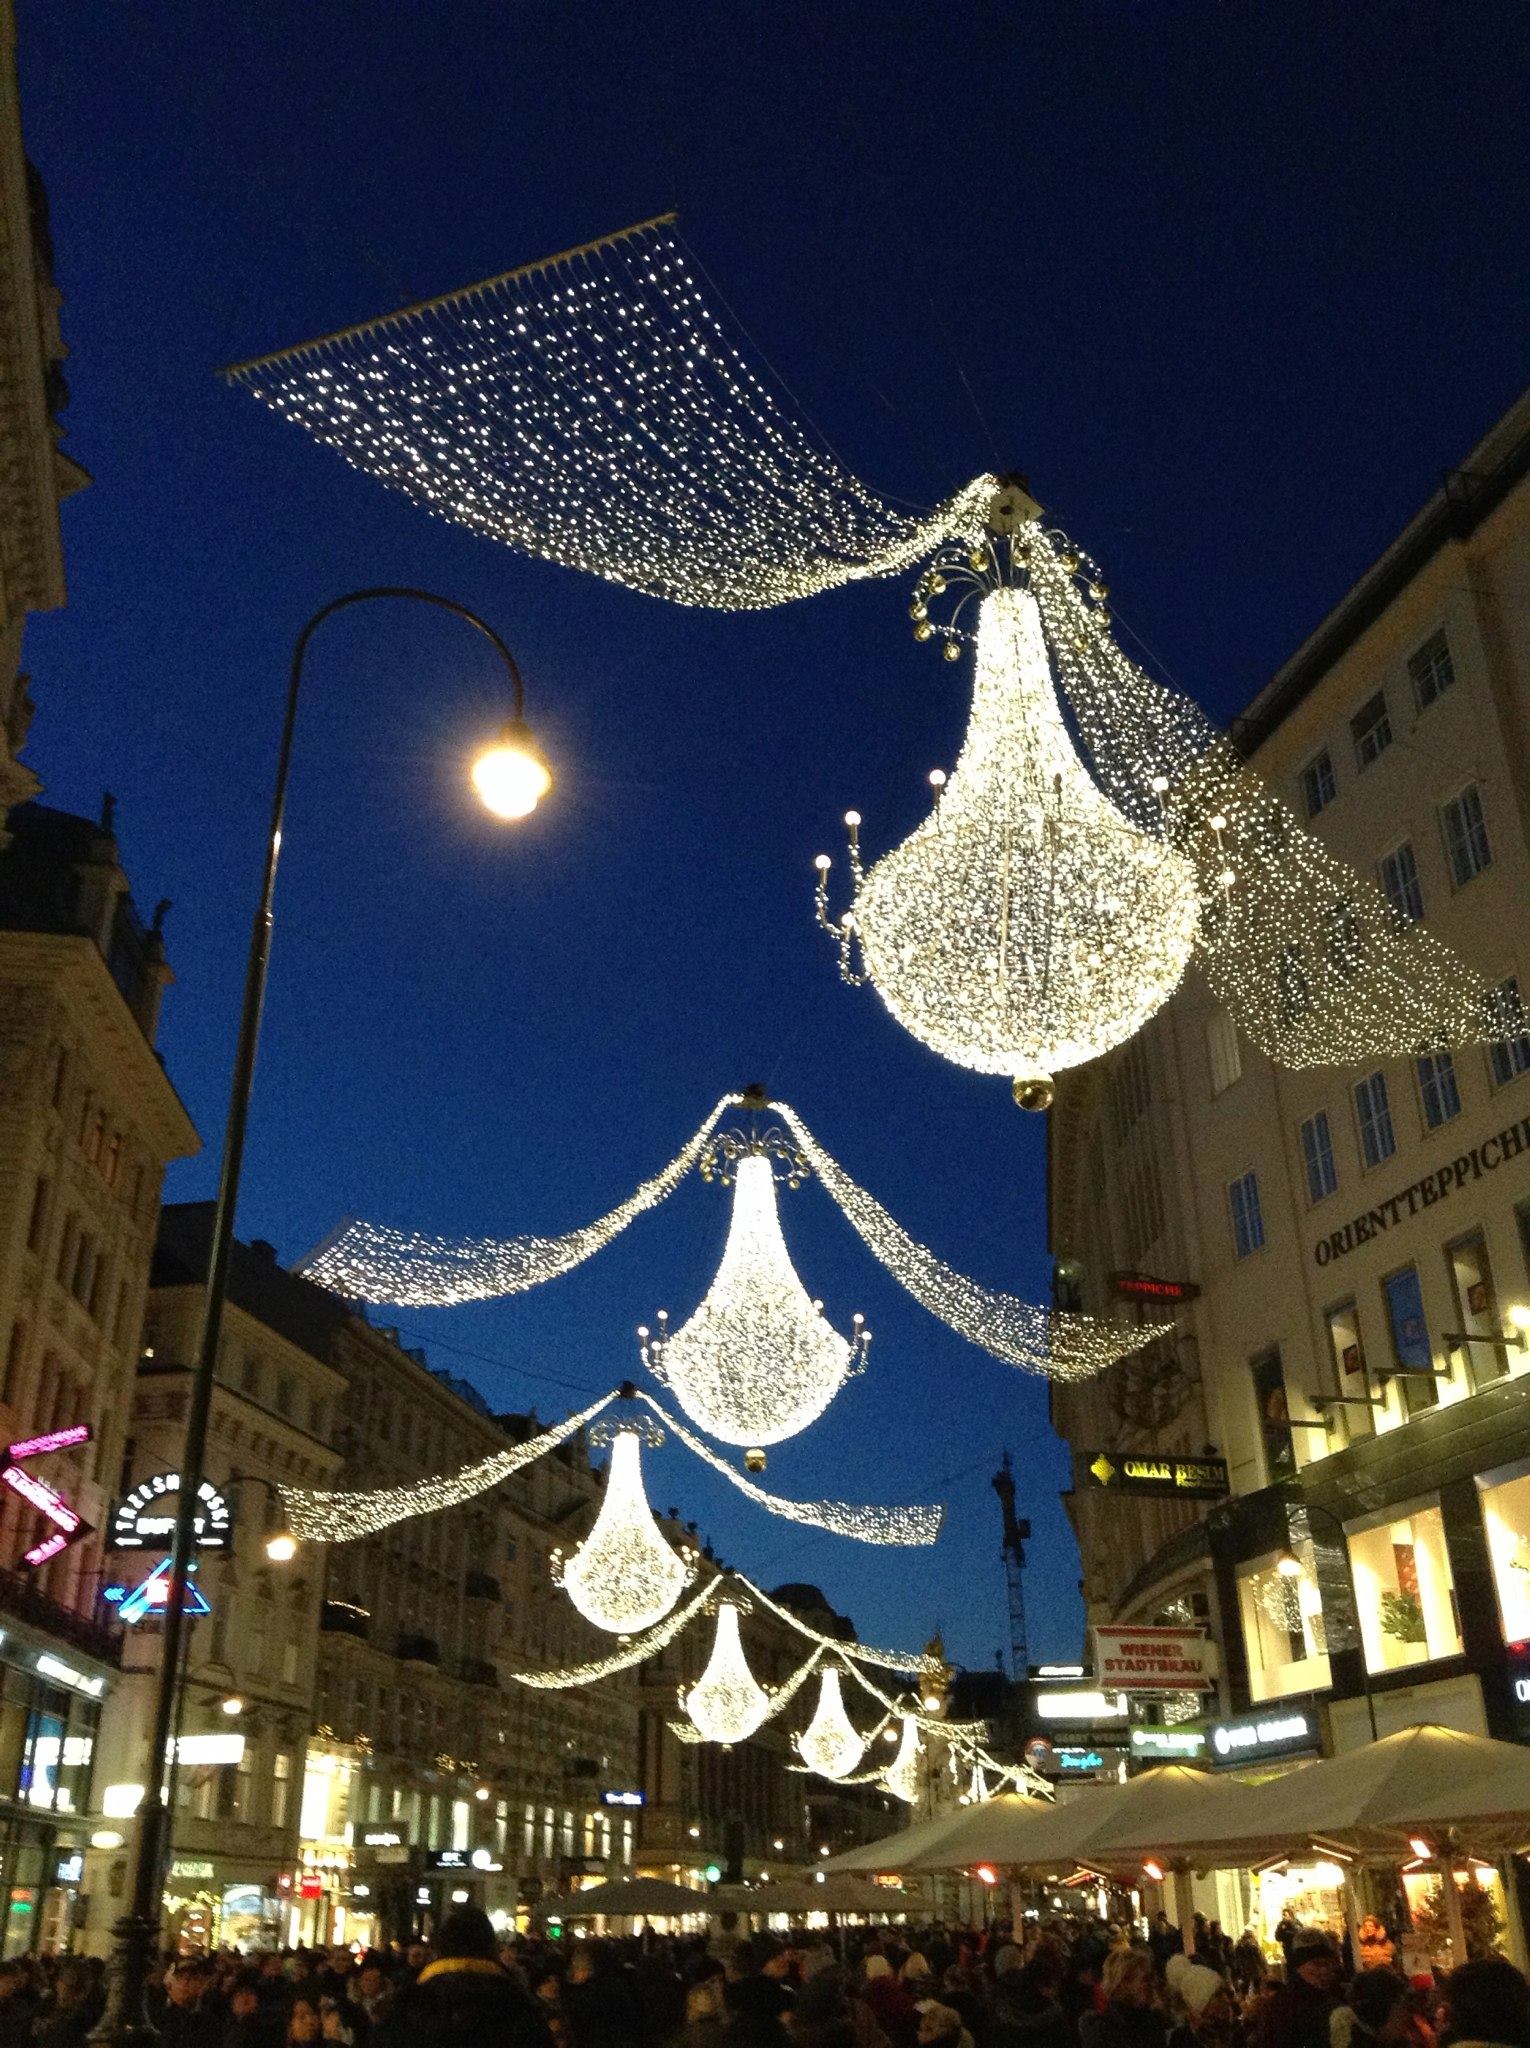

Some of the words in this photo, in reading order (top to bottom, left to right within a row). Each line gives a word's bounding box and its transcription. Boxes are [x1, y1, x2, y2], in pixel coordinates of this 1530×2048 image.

[1124, 1461, 1172, 1479] OMAR
[1175, 1464, 1225, 1482] BESIM
[115, 1473, 229, 1531] TRZESNWSKI
[1119, 1644, 1183, 1656] WIENER
